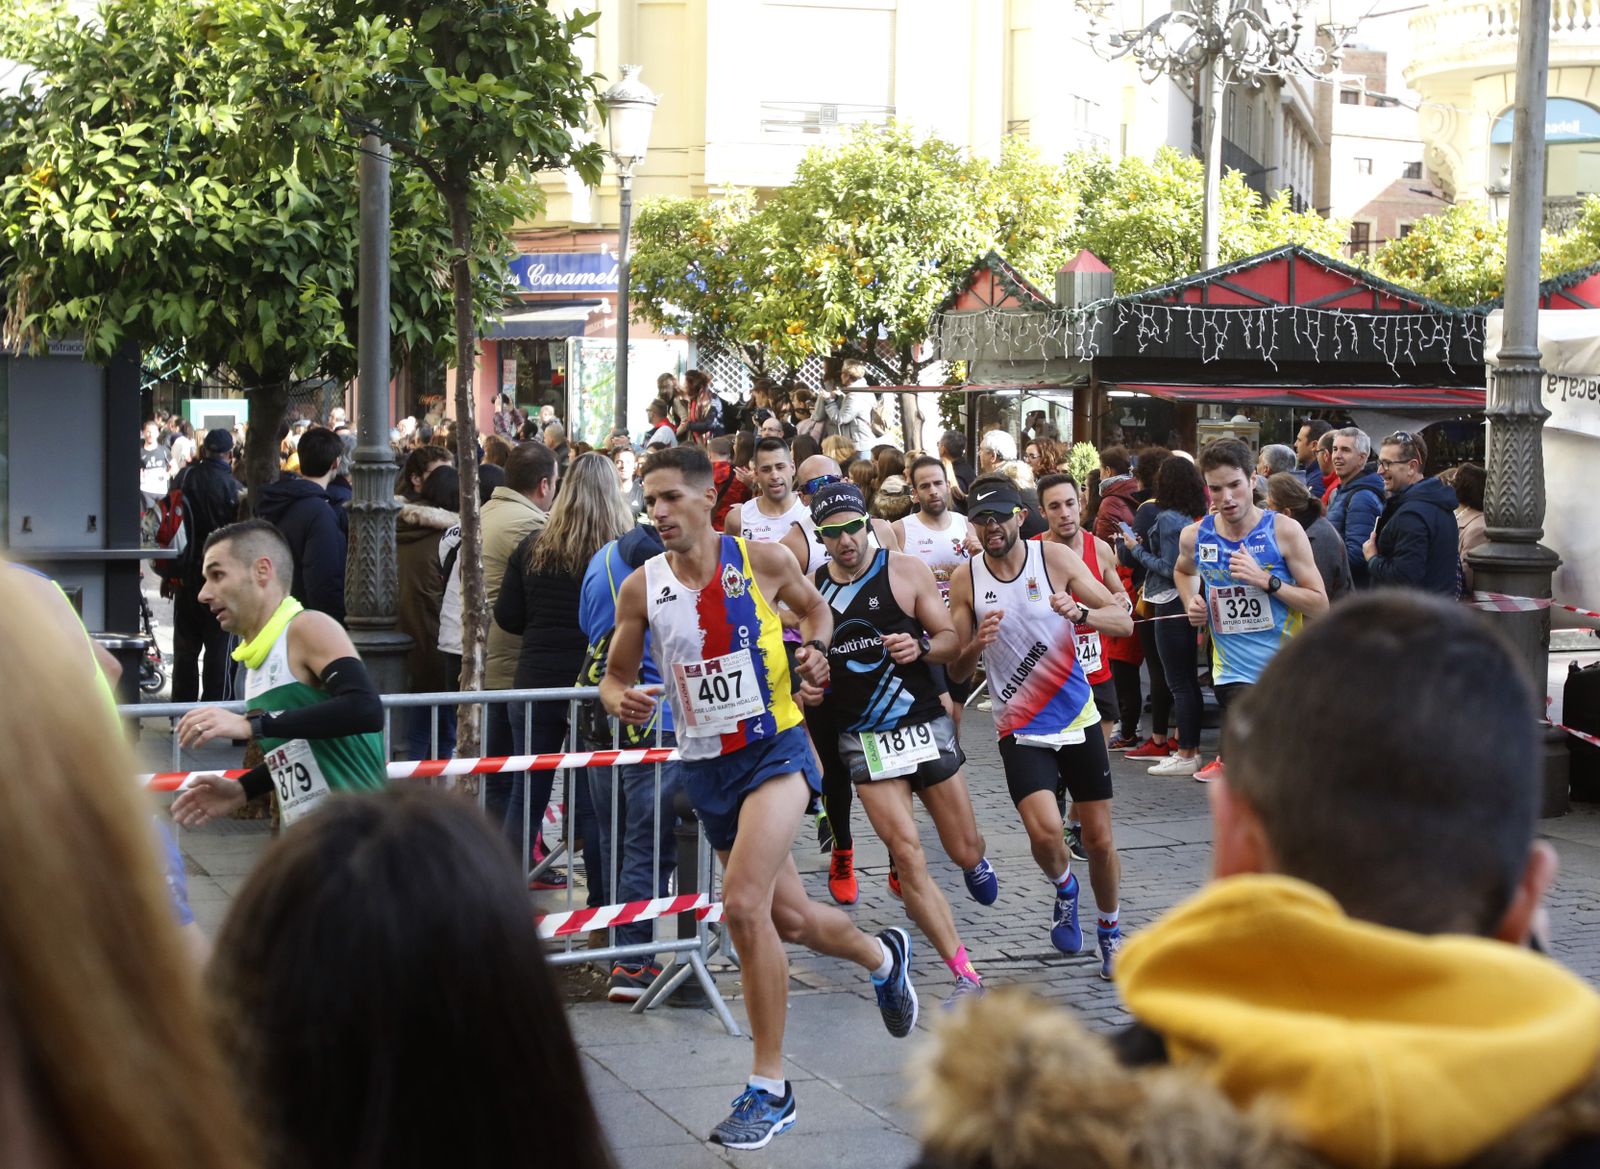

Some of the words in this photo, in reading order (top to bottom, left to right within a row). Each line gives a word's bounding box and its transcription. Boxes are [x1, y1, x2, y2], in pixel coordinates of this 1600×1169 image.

[527, 263, 619, 286] Caramel
[1226, 598, 1262, 619] 329
[698, 670, 742, 704] 407
[998, 683, 1018, 704] LOS
[879, 724, 931, 754] 1819
[278, 762, 312, 801] 879
